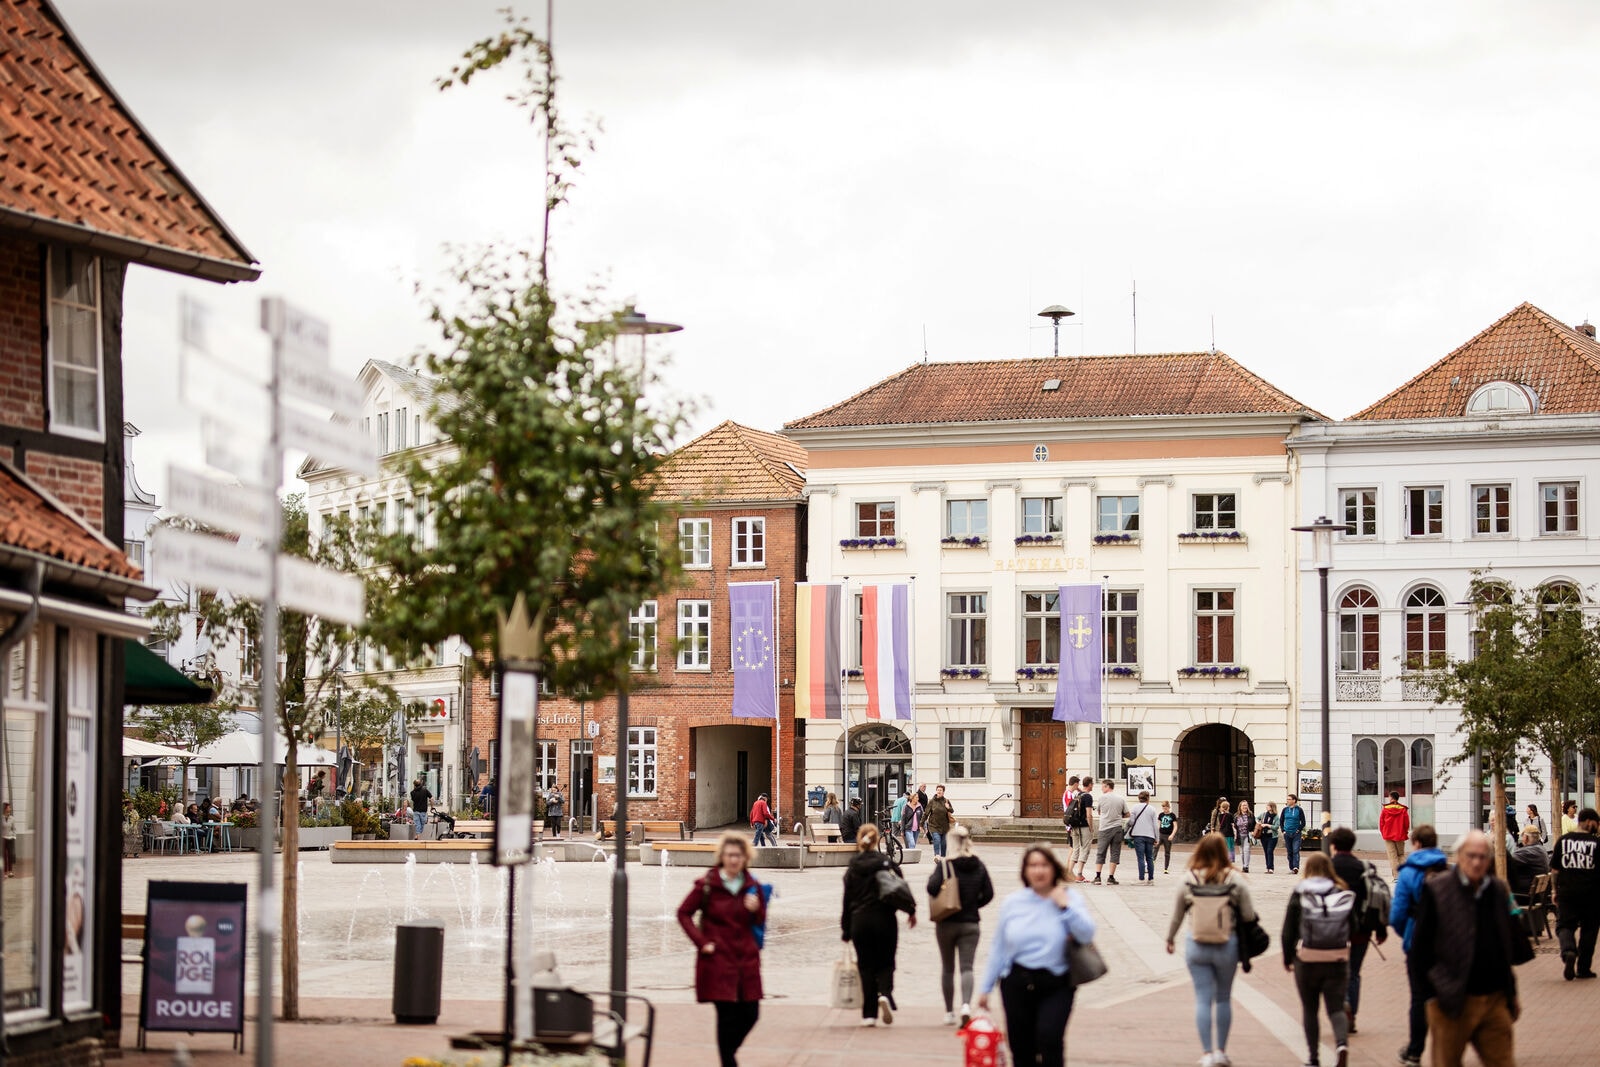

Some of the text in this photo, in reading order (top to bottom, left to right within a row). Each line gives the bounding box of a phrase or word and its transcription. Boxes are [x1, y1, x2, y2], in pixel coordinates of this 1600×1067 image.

[537, 713, 577, 724] ist-Info
[1561, 839, 1597, 856] I DON'T
[1561, 853, 1595, 869] CARE
[156, 999, 233, 1018] ROUGE
